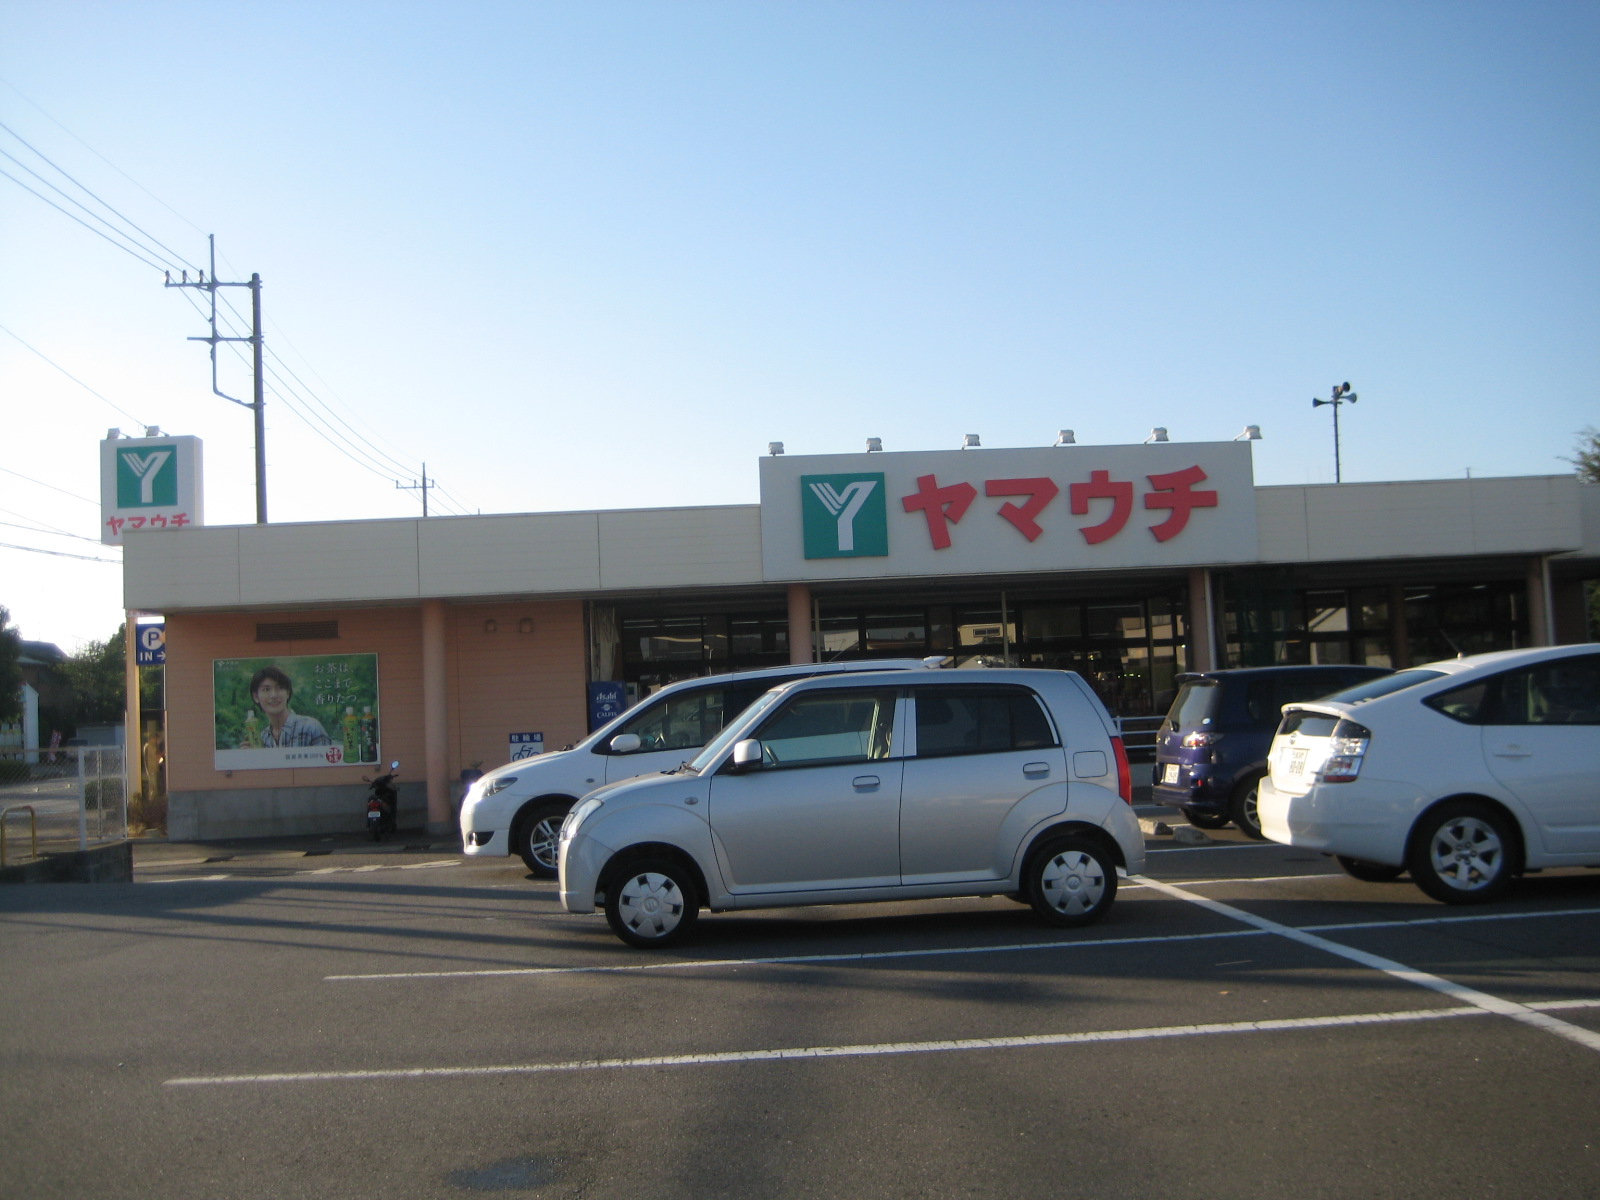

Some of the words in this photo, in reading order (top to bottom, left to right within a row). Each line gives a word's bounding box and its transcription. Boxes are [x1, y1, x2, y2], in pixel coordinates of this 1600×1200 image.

[901, 464, 1218, 551] ヤマウチ
[148, 632, 160, 646] P
[140, 651, 153, 661] IN
[315, 677, 353, 689] ここまで
[596, 691, 617, 700] Asahi
